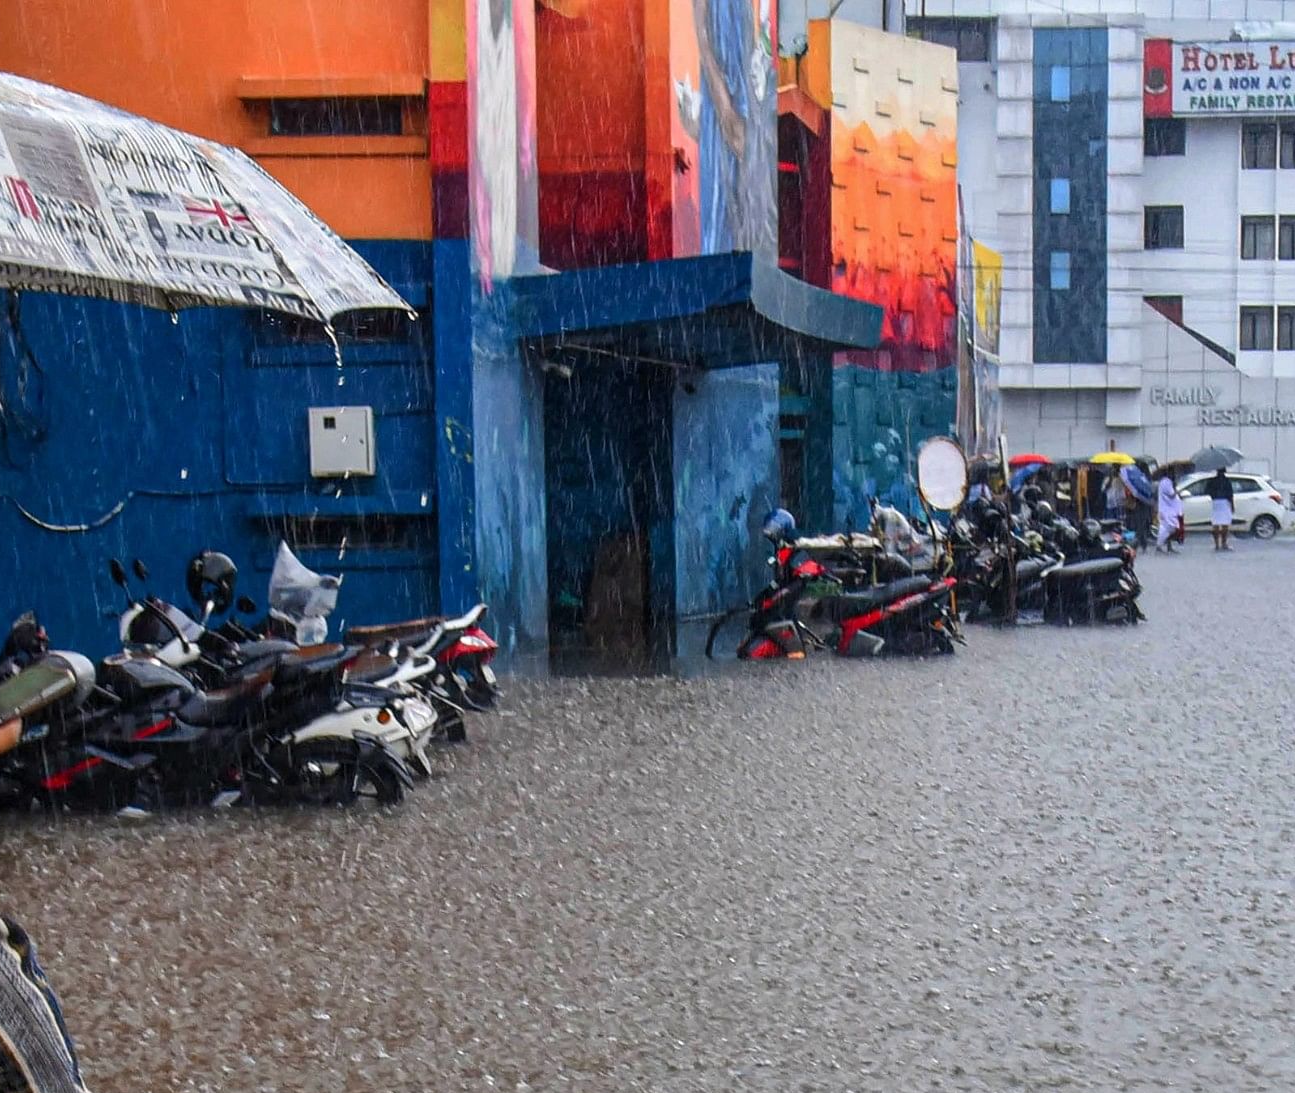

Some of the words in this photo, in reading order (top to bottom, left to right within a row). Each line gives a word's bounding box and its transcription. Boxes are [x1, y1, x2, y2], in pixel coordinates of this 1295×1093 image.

[1181, 46, 1260, 71] HOTEL
[1182, 77, 1208, 91] A/C
[1229, 77, 1261, 90] NON
[1266, 76, 1292, 90] A/C
[1190, 95, 1241, 110] FAMILY
[1150, 386, 1220, 406] FAMILY
